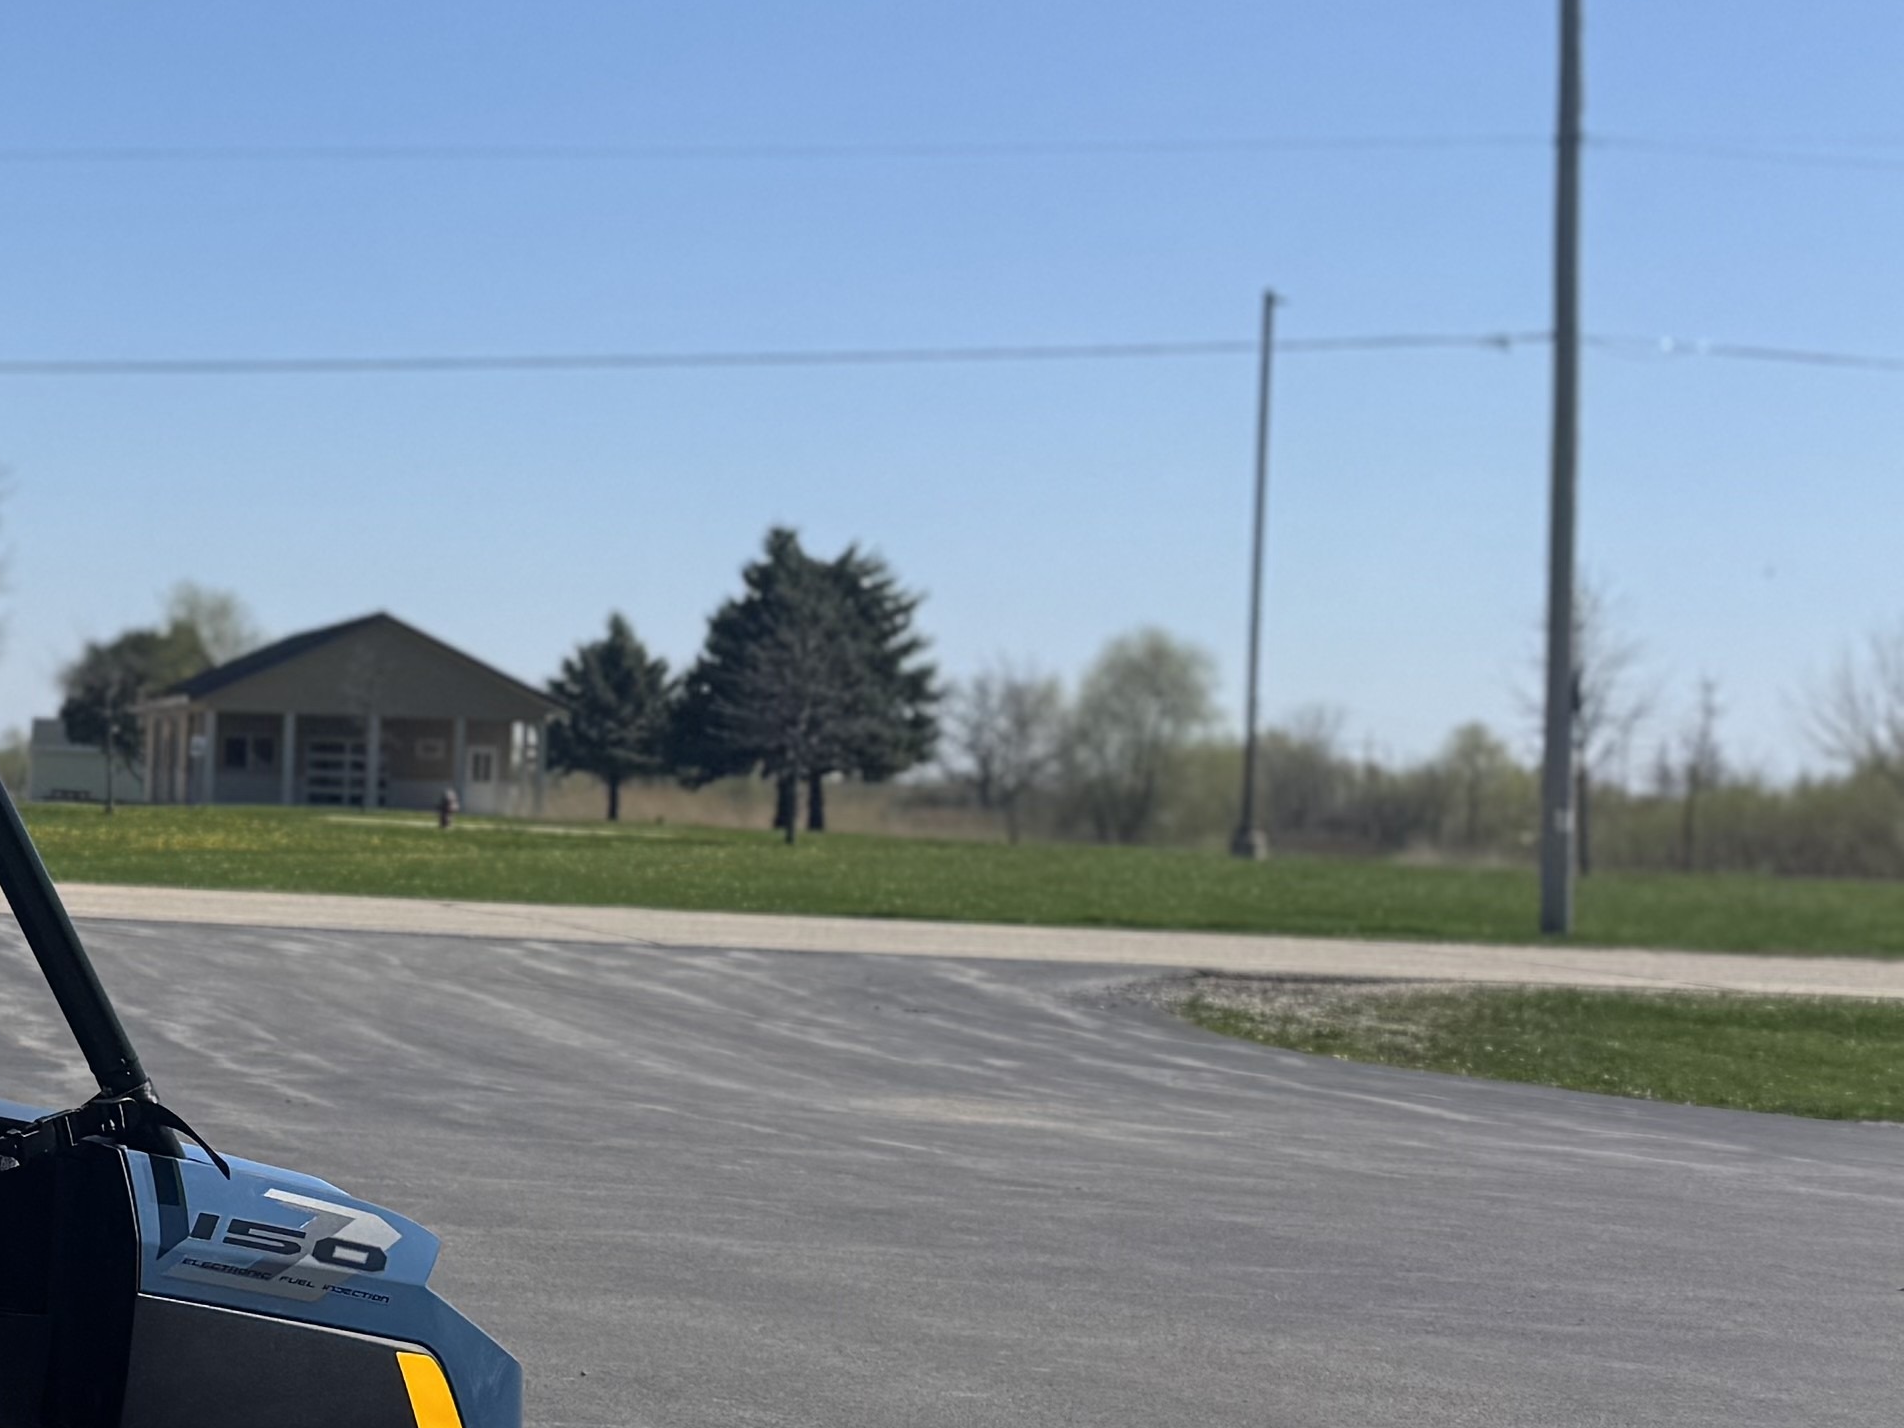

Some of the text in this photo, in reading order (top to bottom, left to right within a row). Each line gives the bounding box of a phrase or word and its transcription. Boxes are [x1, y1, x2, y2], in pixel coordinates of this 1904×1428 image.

[189, 1211, 388, 1272] 150
[182, 1257, 391, 1304] ELECTRONIC FUEL INJECTION
